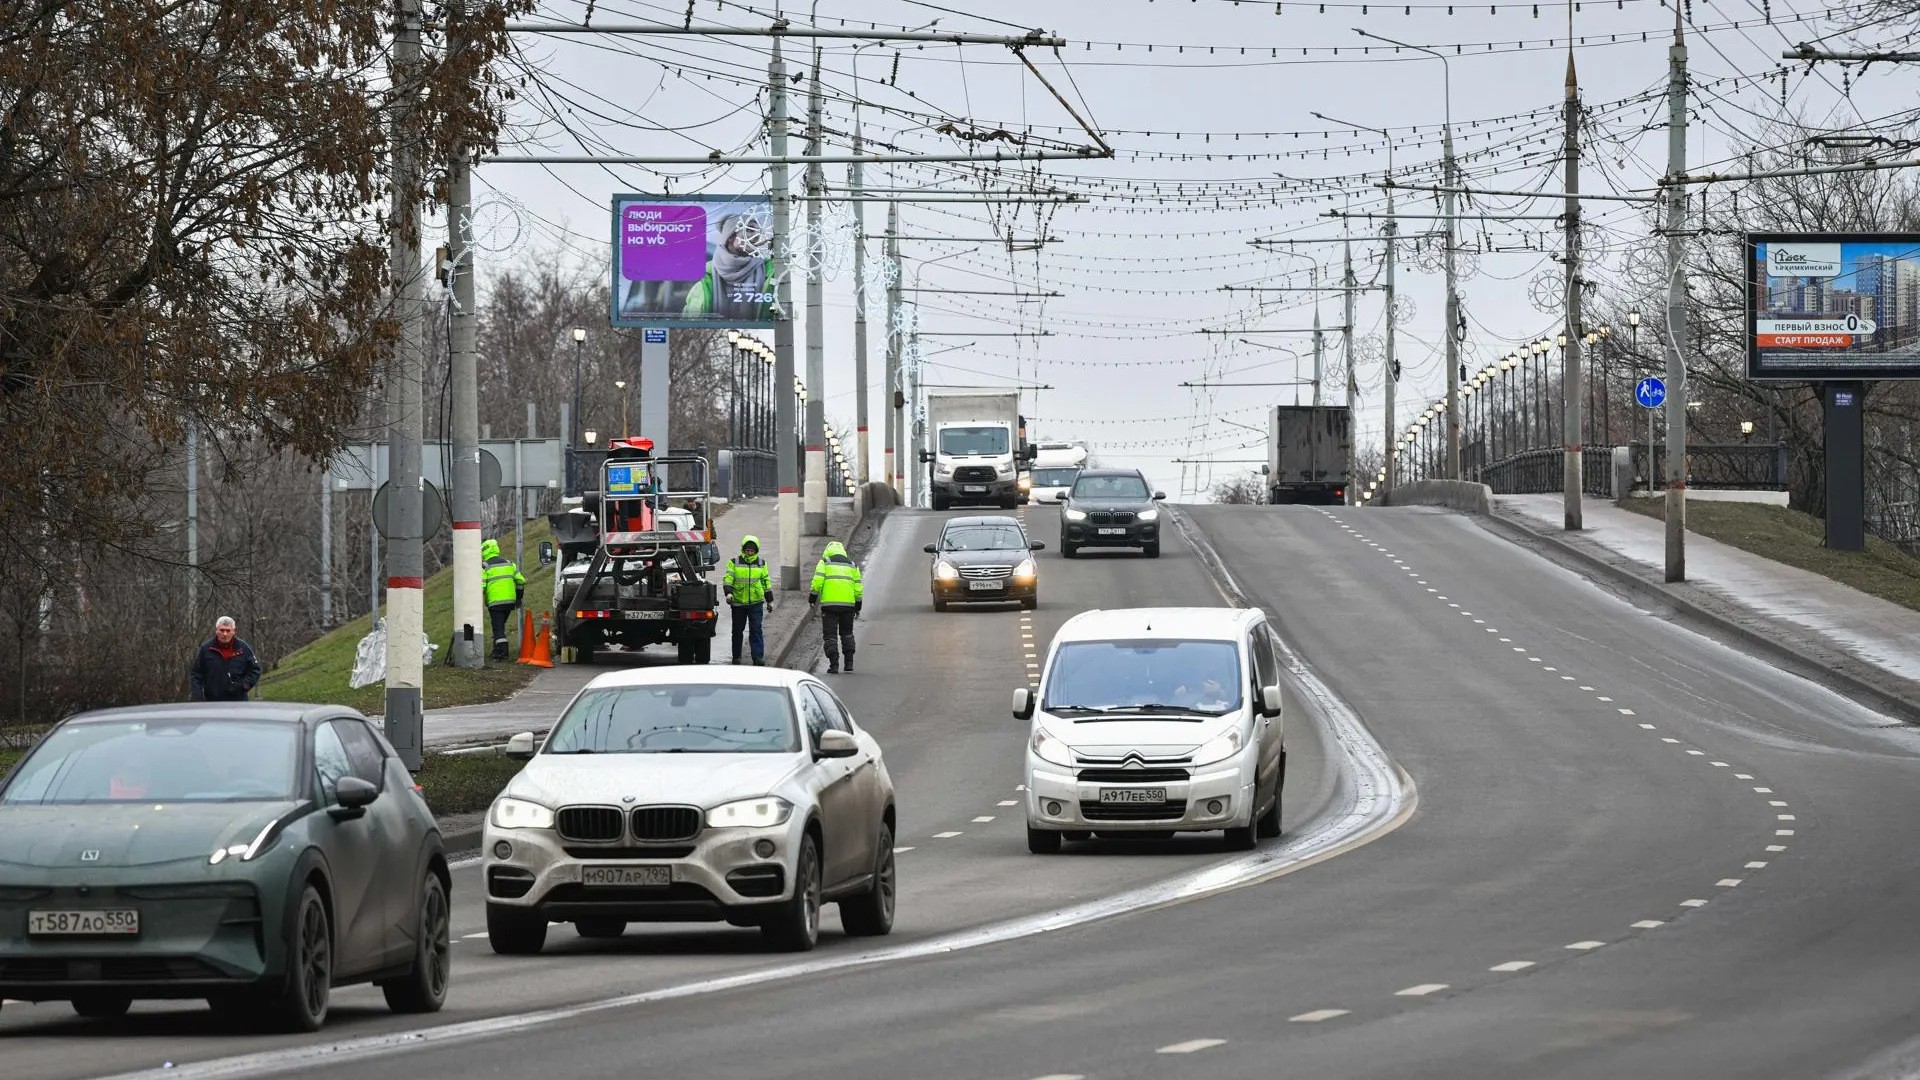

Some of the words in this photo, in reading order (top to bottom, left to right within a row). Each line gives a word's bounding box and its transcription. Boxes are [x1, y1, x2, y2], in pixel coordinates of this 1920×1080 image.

[628, 211, 662, 220] люди
[628, 223, 693, 234] выбирают
[627, 236, 644, 245] на
[647, 234, 666, 245] wb
[1774, 322, 1812, 331] ПЕРВЫЙ
[1814, 323, 1845, 331] ВЗНОС
[1774, 336, 1802, 344] СТАРТ
[1804, 336, 1844, 345] ПРОДАЖ
